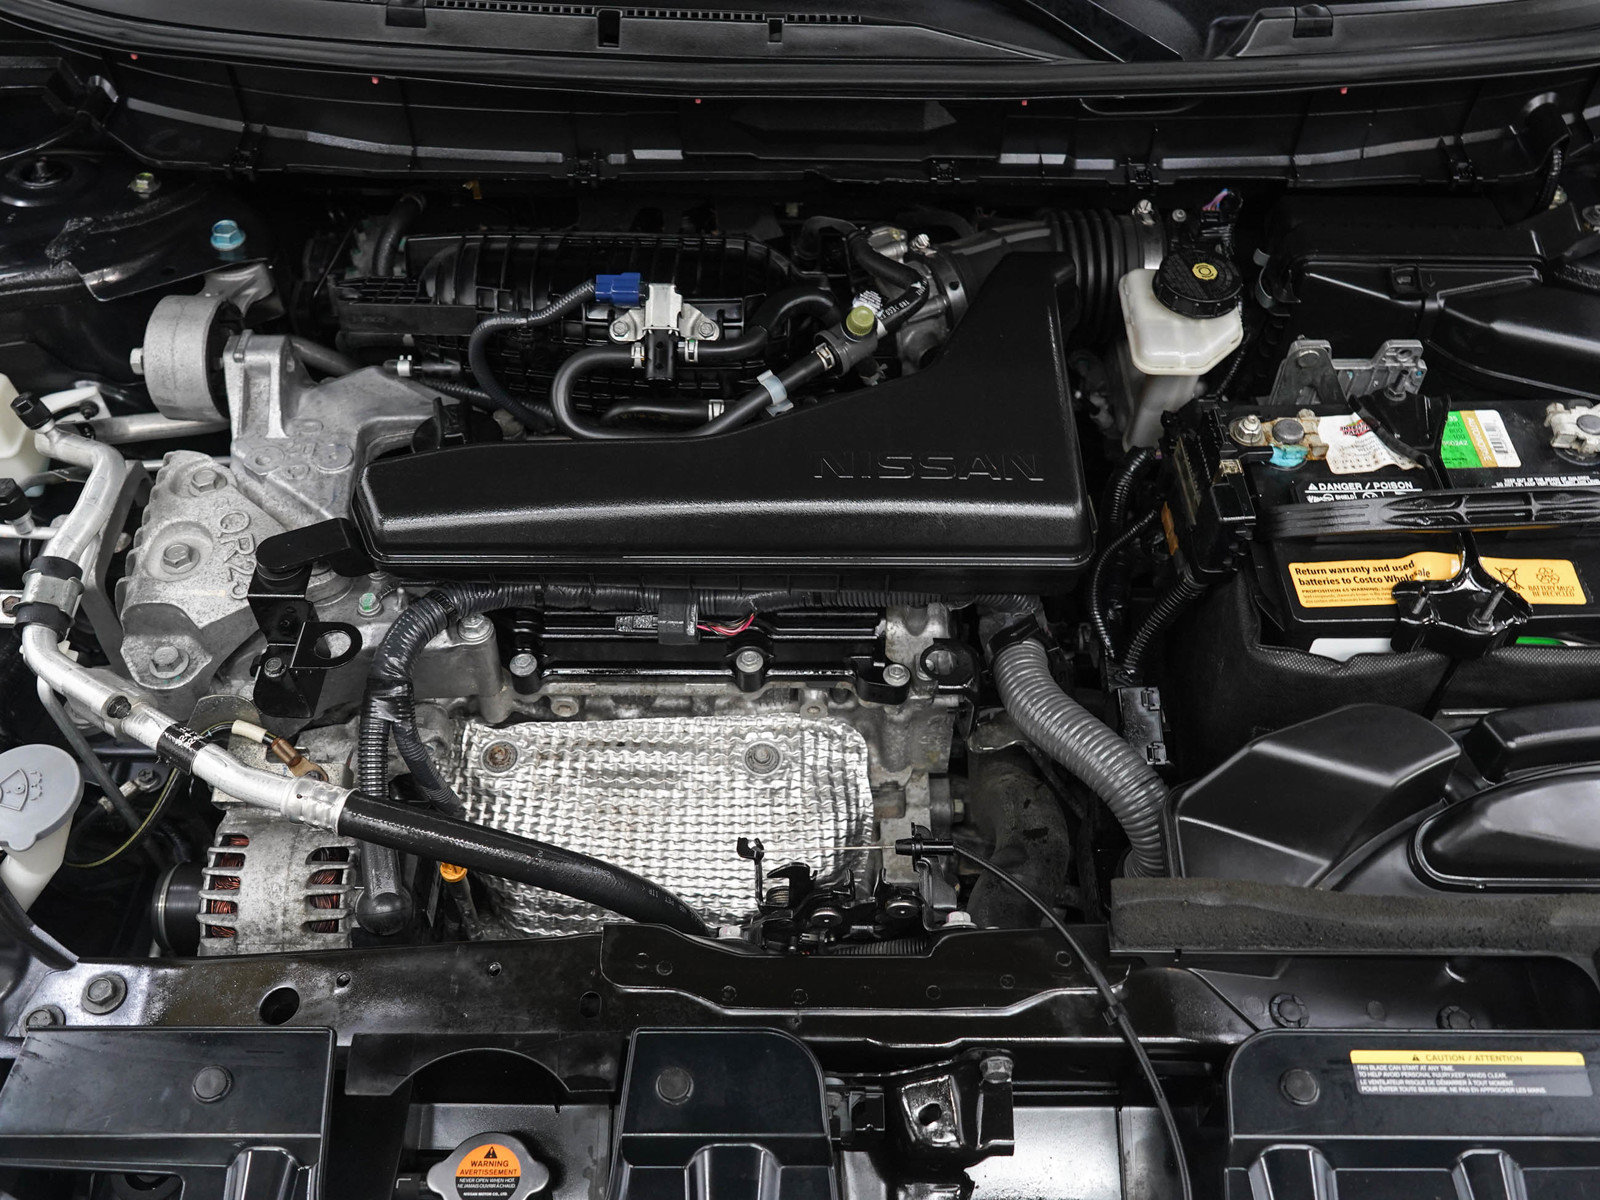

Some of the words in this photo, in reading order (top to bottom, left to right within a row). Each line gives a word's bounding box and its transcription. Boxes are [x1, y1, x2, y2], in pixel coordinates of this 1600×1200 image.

[814, 454, 1044, 481] NISSAN
[1319, 482, 1362, 490] DANGER
[1365, 482, 1371, 490] /
[1373, 481, 1413, 489] POISON
[1295, 567, 1327, 576] Return
[1329, 565, 1371, 575] warranty
[1372, 564, 1391, 573] and
[1392, 560, 1415, 572] used
[1298, 577, 1340, 586] batteries
[1342, 576, 1352, 585] to
[1353, 575, 1383, 584] Costco
[1384, 568, 1431, 583] Wholesale
[1425, 1054, 1465, 1062] CAUTION
